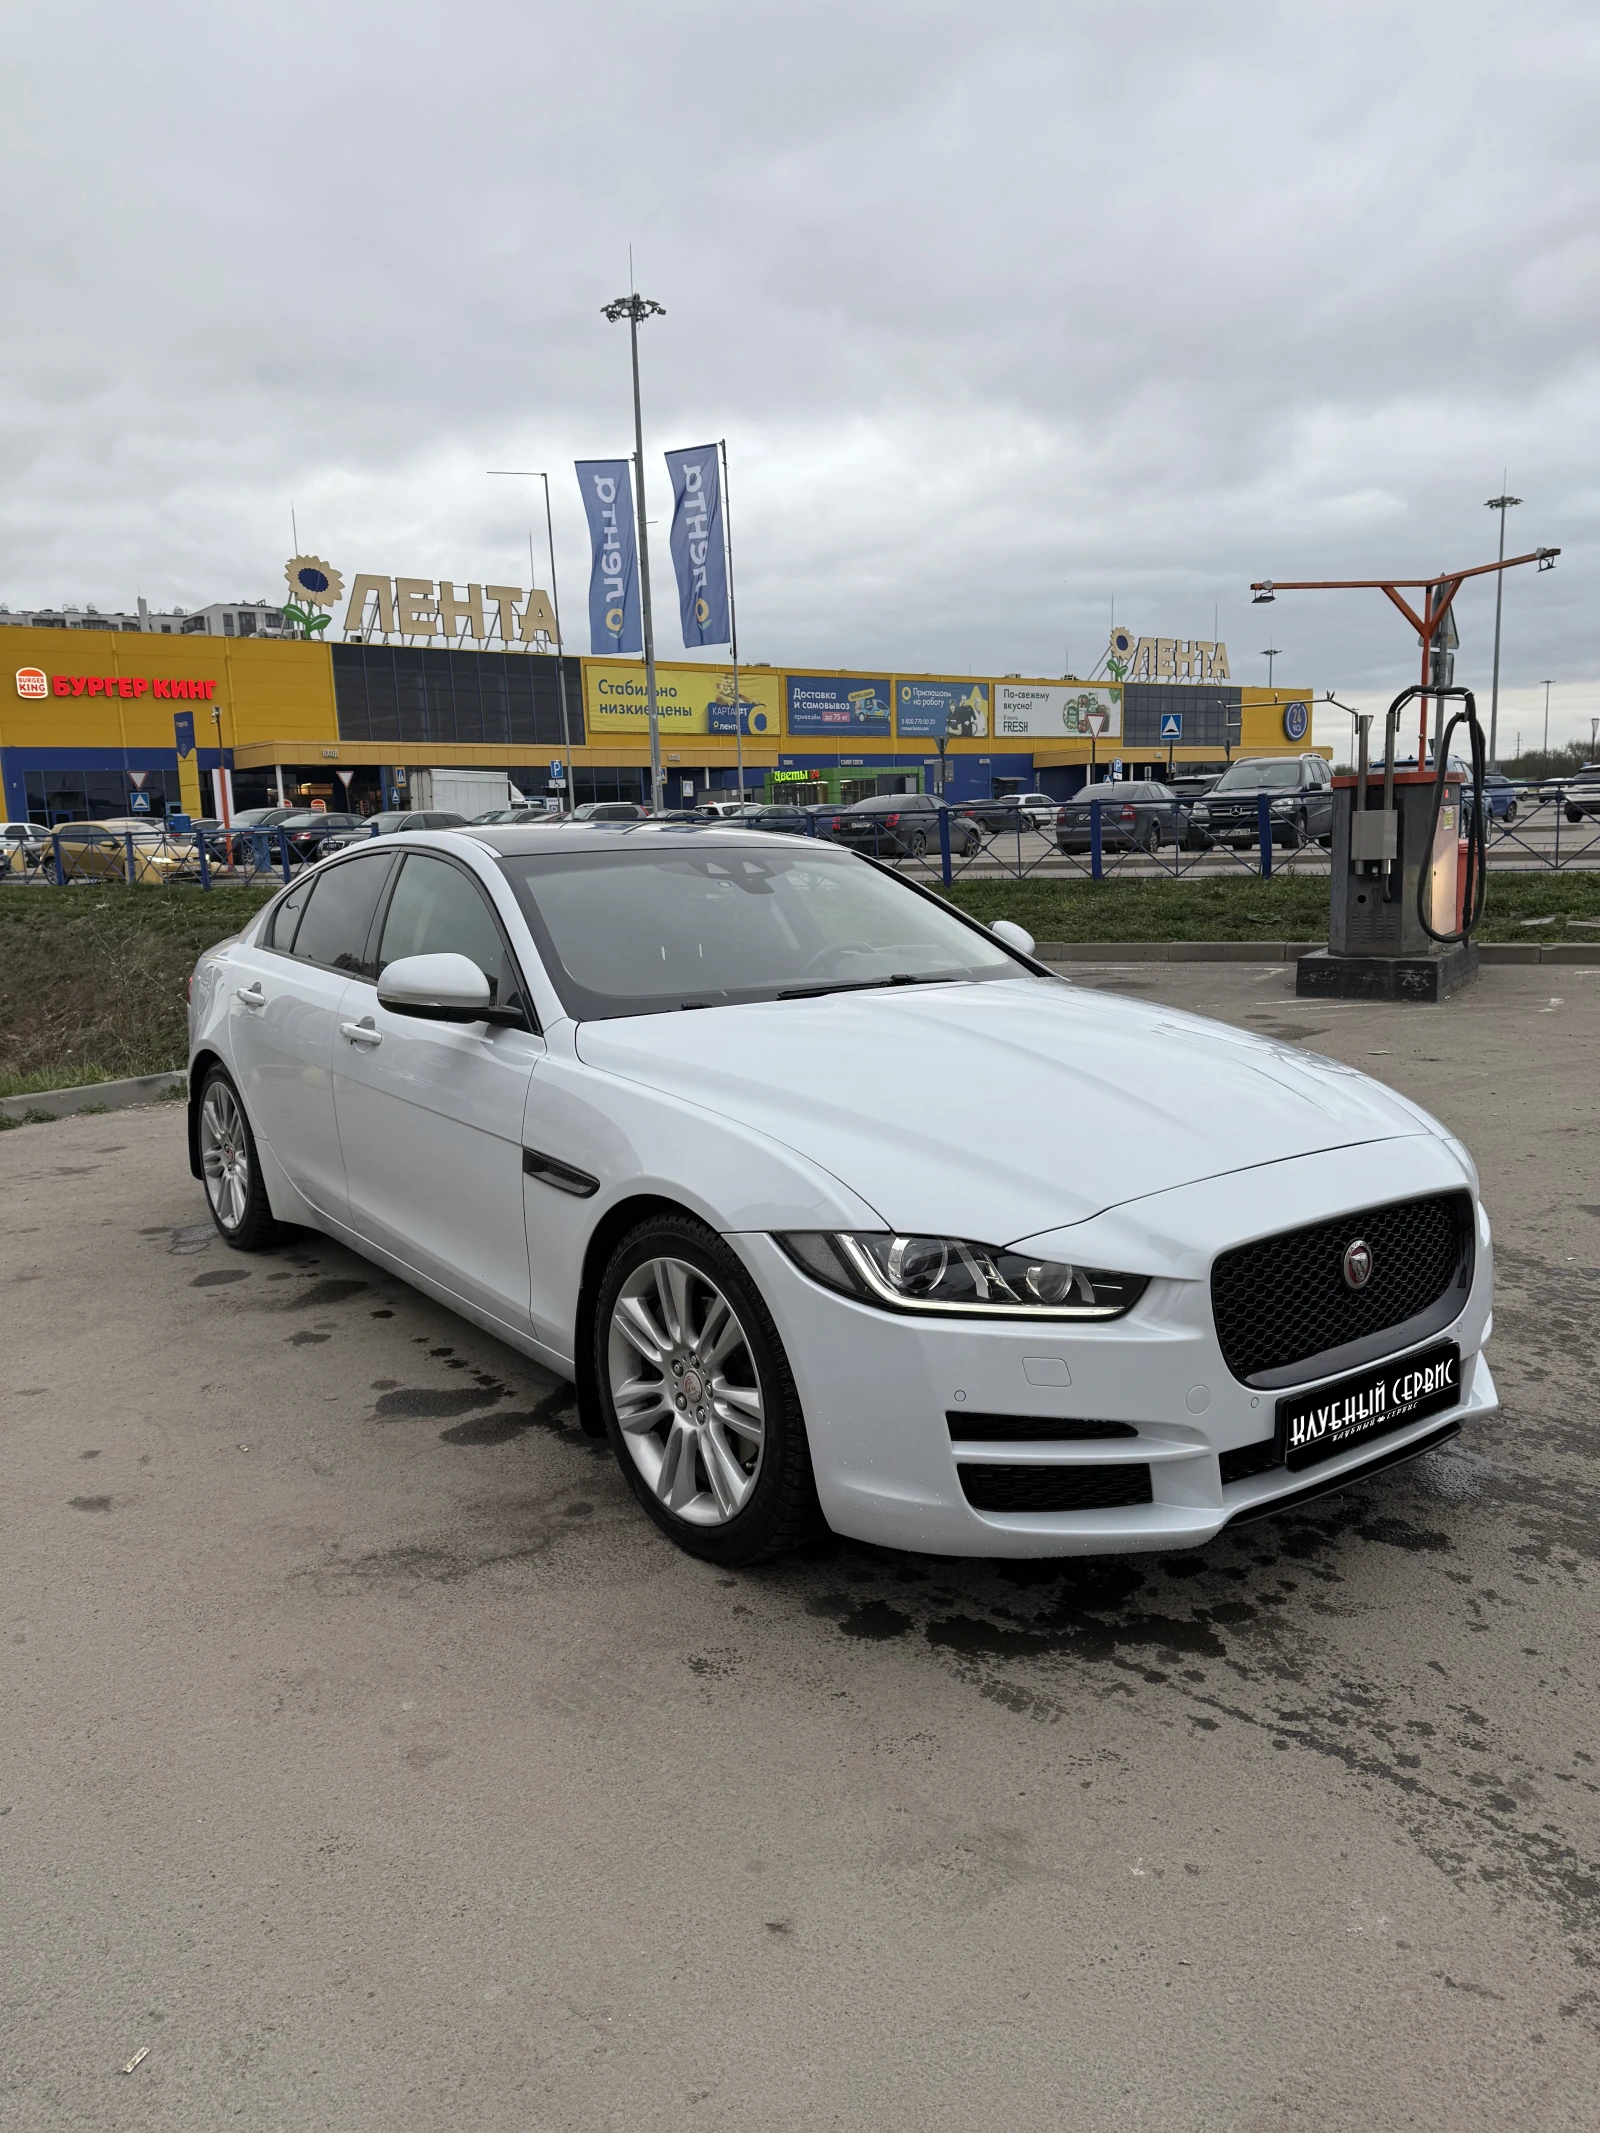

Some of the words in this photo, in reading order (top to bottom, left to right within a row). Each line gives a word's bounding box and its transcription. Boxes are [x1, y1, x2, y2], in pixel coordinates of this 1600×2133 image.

[343, 573, 562, 645] ЛЕНТА
[1132, 637, 1231, 679] ЛЕНТА
[19, 683, 46, 692] KING
[52, 675, 149, 698] БУРГЕР
[153, 678, 217, 700] КИНГ
[912, 687, 951, 698] Приглашаем
[793, 688, 837, 700] Доставка
[1003, 688, 1050, 702] По-свежему
[802, 702, 850, 710] самовывоз
[922, 697, 945, 708] работу
[1003, 701, 1033, 712] вкусно!
[599, 704, 650, 716] низкие
[656, 705, 692, 718] цены
[712, 706, 736, 716] КАРТА
[834, 713, 841, 721] 75
[1292, 708, 1302, 724] 24
[1003, 721, 1029, 733] FRESH
[774, 770, 808, 783] Цветы
[810, 769, 820, 779] 24
